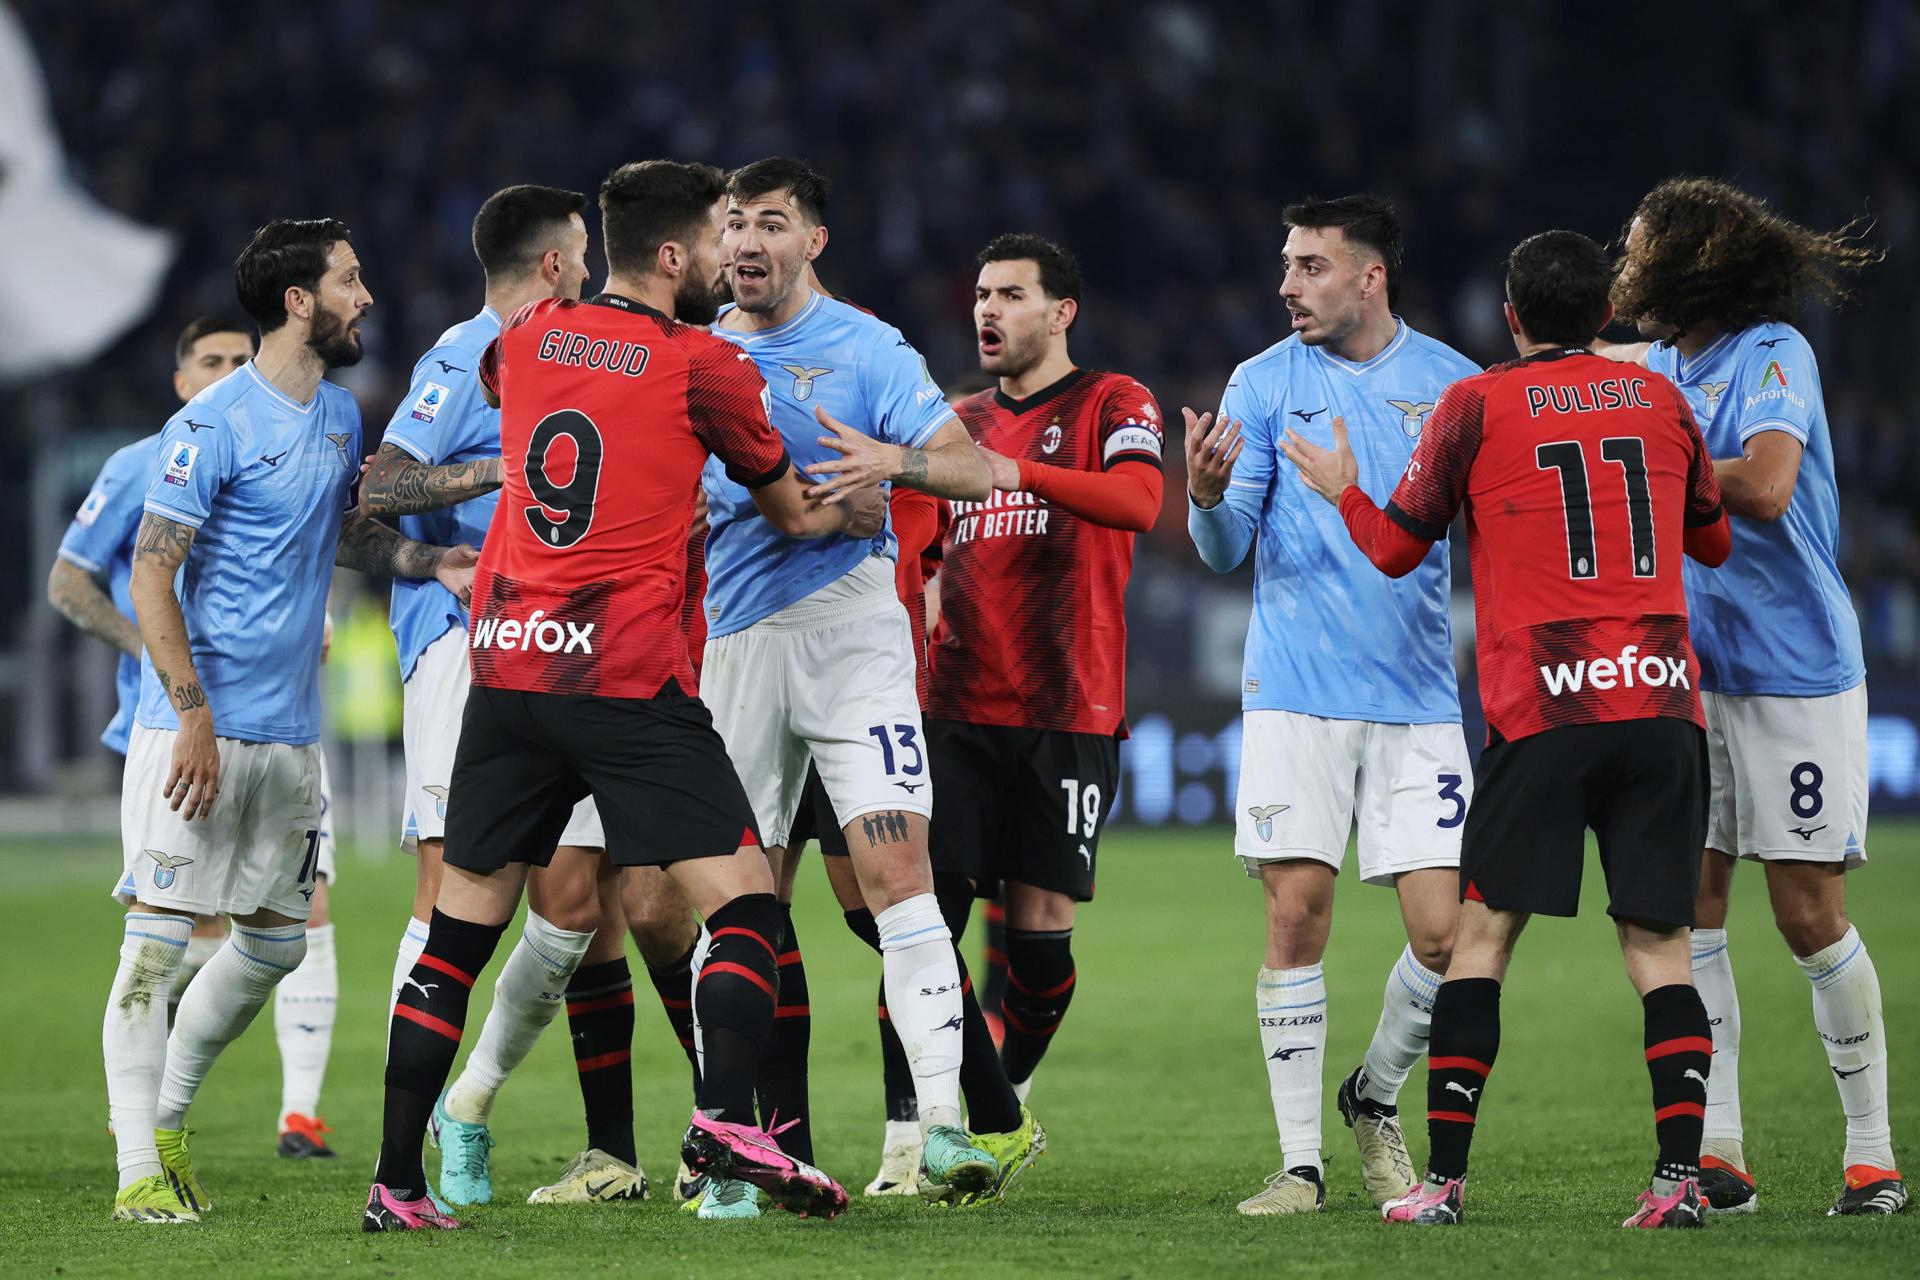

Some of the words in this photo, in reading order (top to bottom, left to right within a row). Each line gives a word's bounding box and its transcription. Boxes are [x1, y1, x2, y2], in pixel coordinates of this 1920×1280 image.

[610, 298, 628, 308] MILAN
[538, 329, 650, 377] GIROUD
[1526, 378, 1652, 417] PULISIC
[523, 409, 604, 548] 9
[955, 516, 979, 545] FLY
[983, 509, 1048, 539] BETTER
[1536, 437, 1656, 579] 11
[473, 610, 595, 654] wefox
[1540, 645, 1691, 696] wefox
[869, 724, 923, 776] 13
[1061, 779, 1101, 839] 19
[1436, 774, 1466, 828] 3
[1790, 761, 1823, 818] 8
[297, 830, 320, 883] 1
